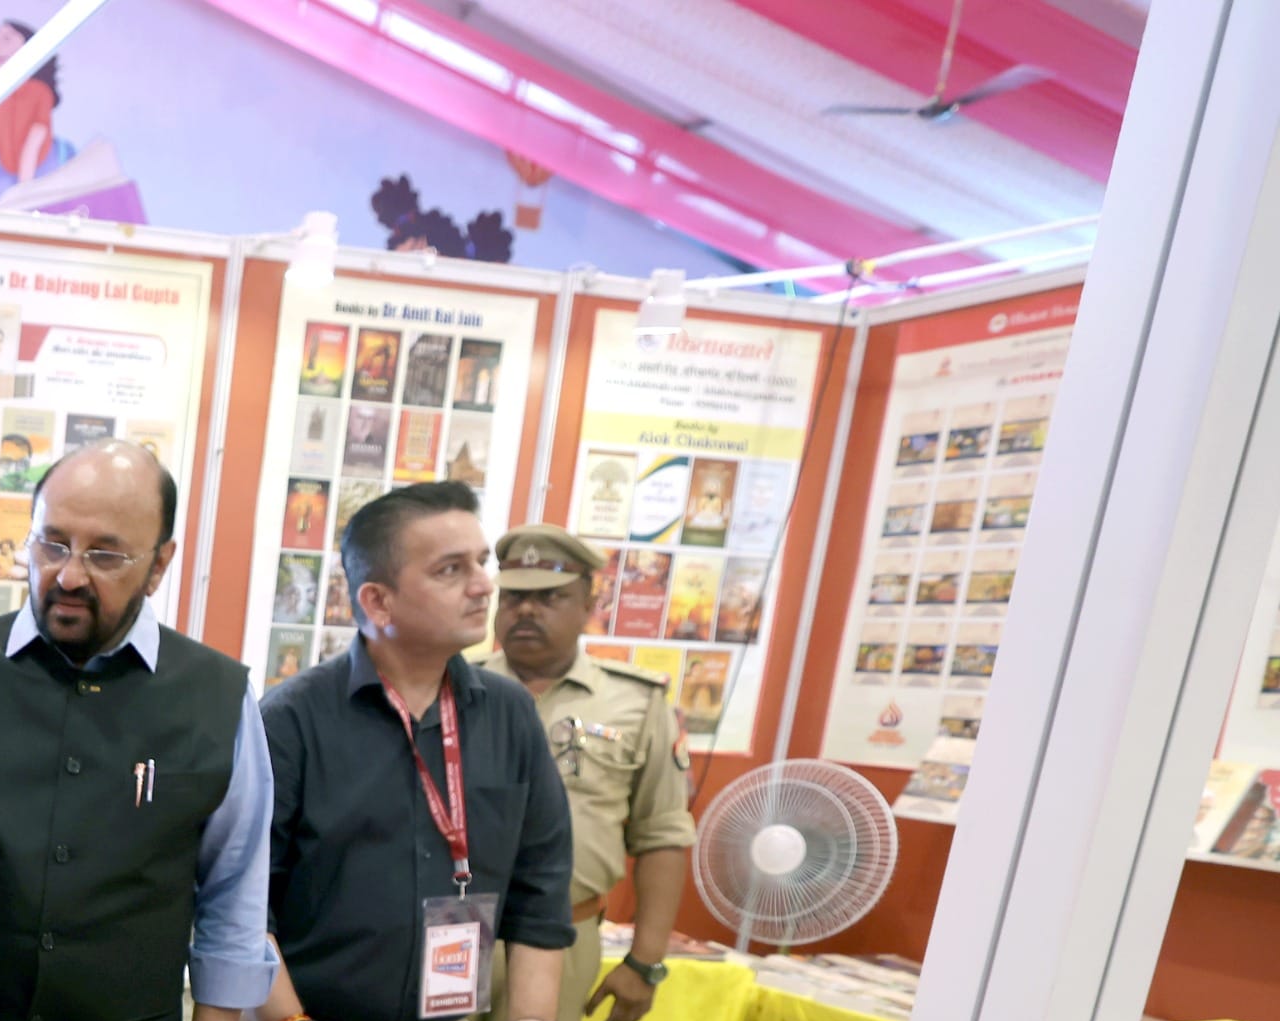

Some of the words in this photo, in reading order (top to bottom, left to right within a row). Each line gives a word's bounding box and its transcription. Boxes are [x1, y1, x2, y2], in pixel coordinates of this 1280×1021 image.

[34, 275, 100, 300] Bajrang
[104, 280, 128, 299] Lal
[132, 284, 180, 305] Gupta
